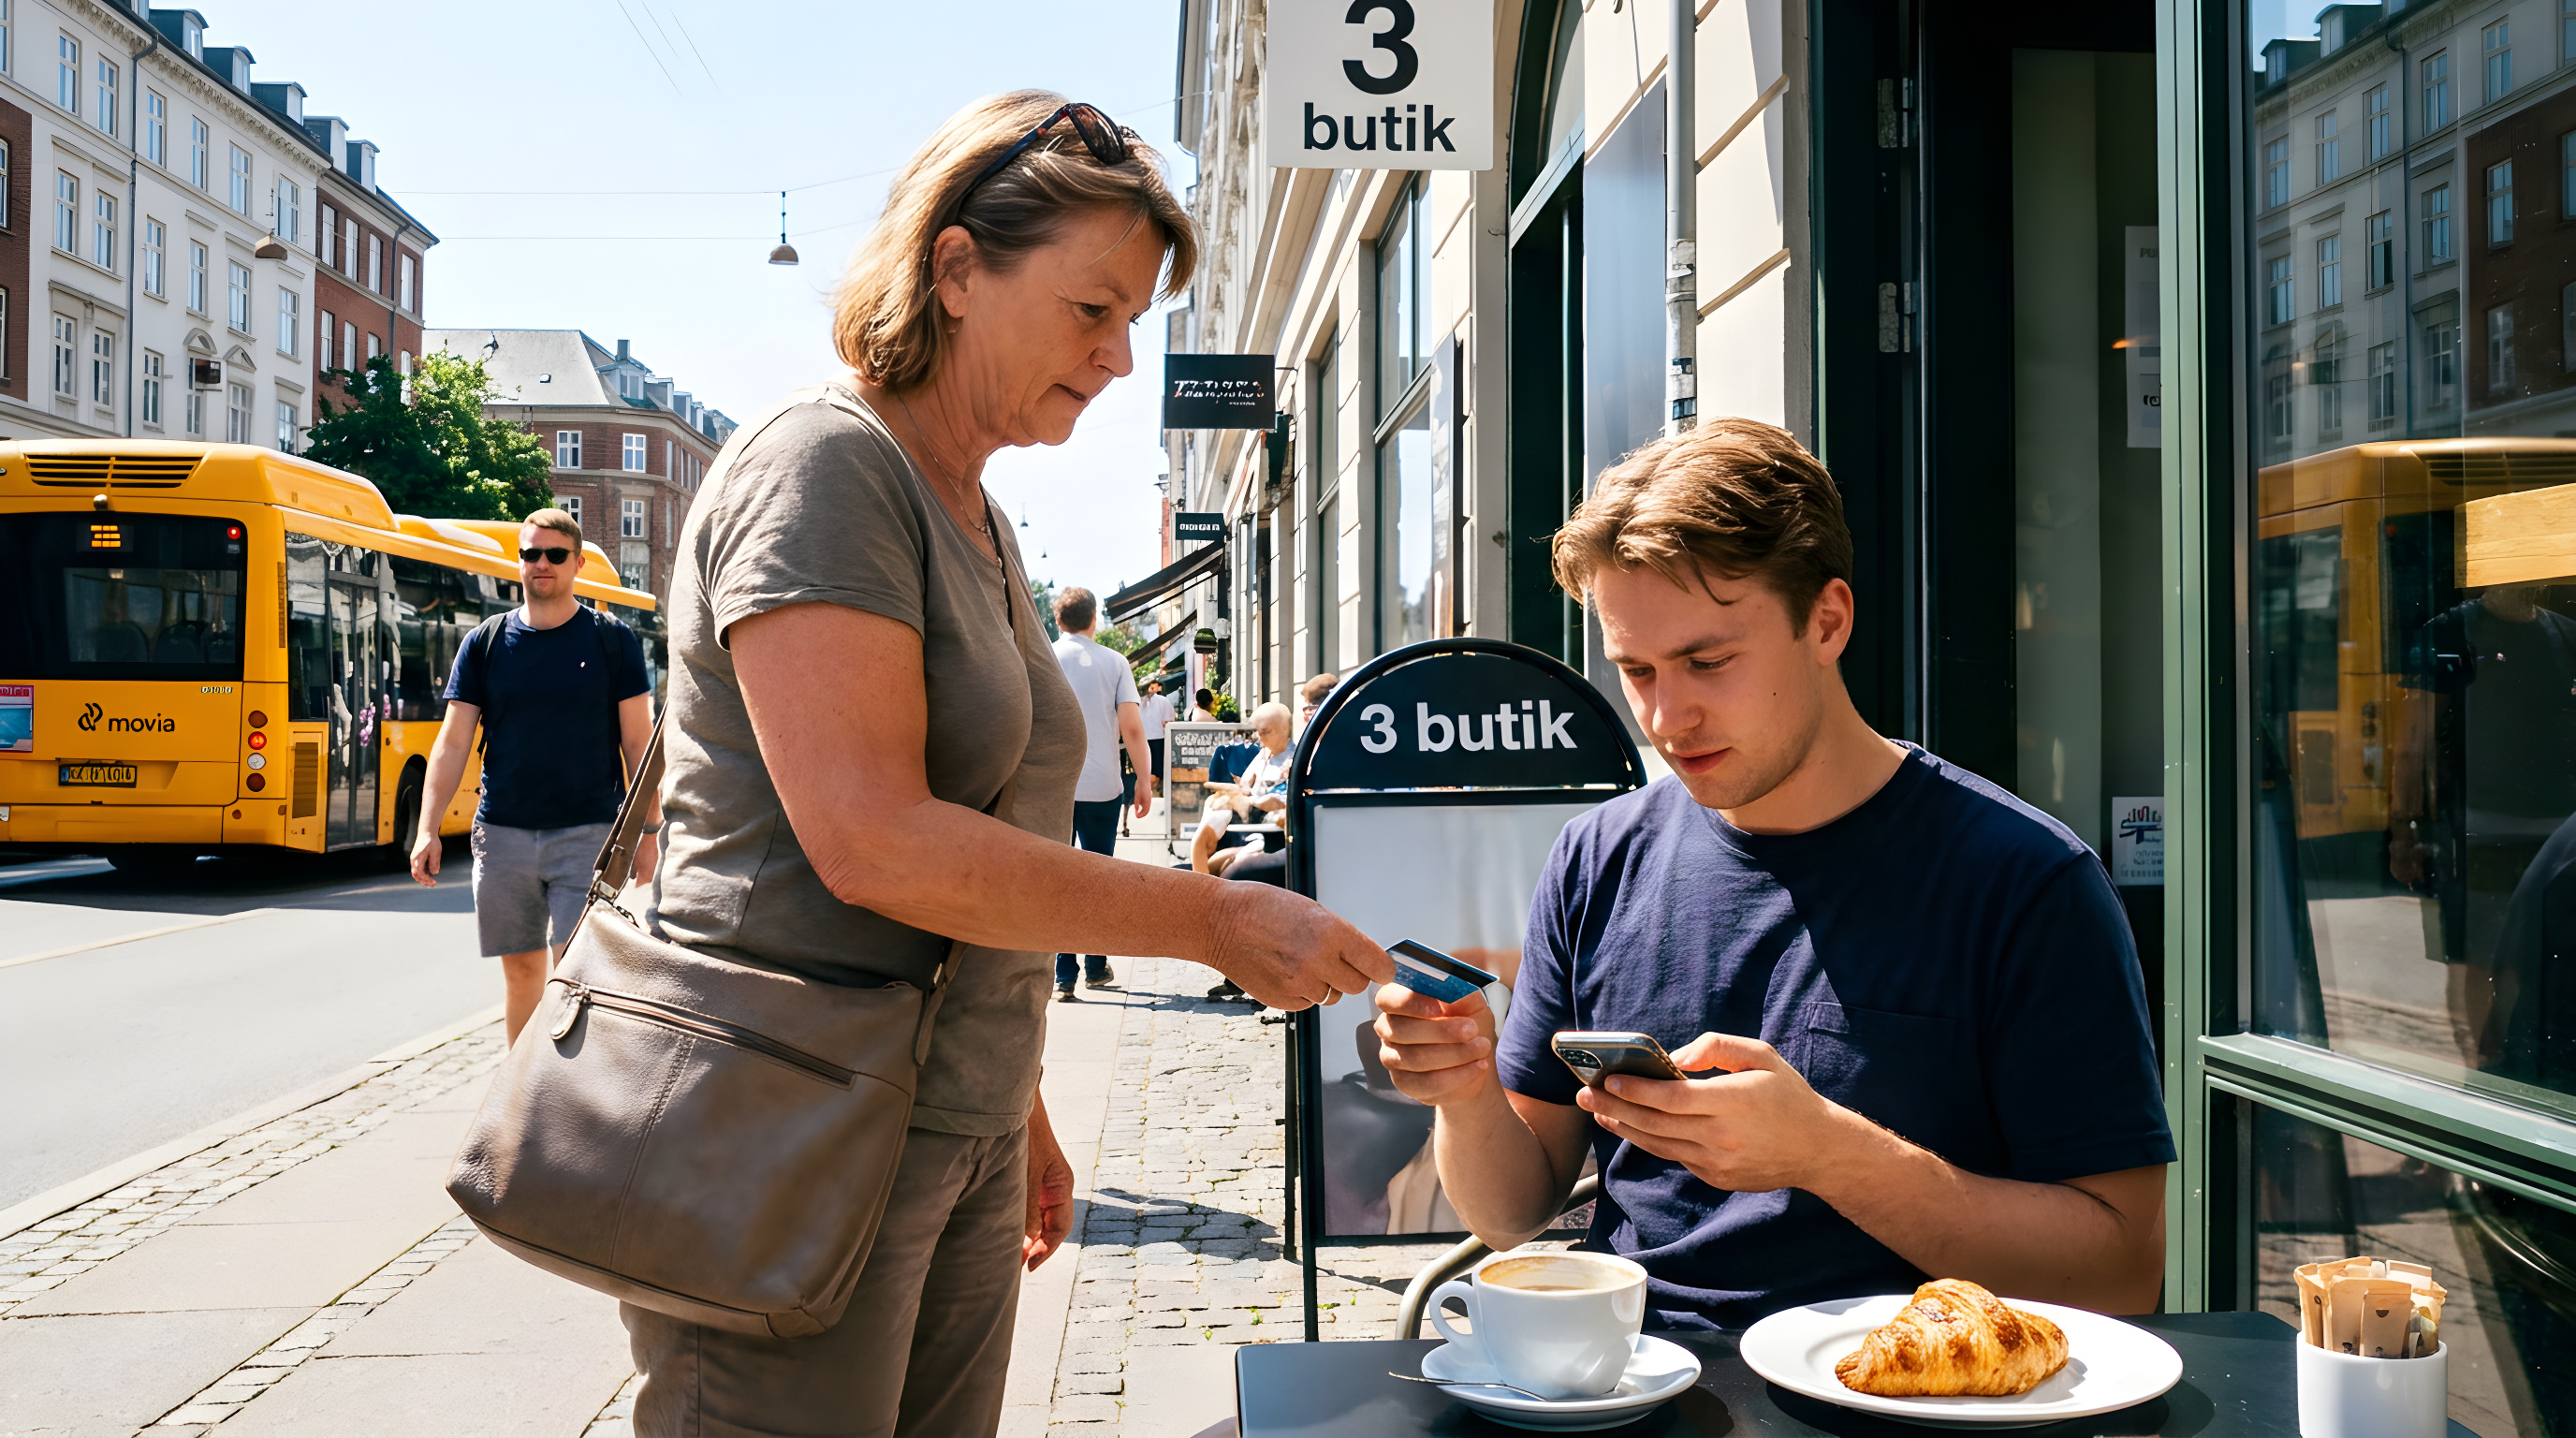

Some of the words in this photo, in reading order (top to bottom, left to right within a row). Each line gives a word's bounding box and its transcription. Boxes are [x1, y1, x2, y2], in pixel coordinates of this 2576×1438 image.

[1341, 0, 1419, 95] 3
[1303, 102, 1456, 153] butik
[108, 712, 176, 733] movia
[1360, 703, 1398, 754] 3
[1417, 699, 1578, 753] butik
